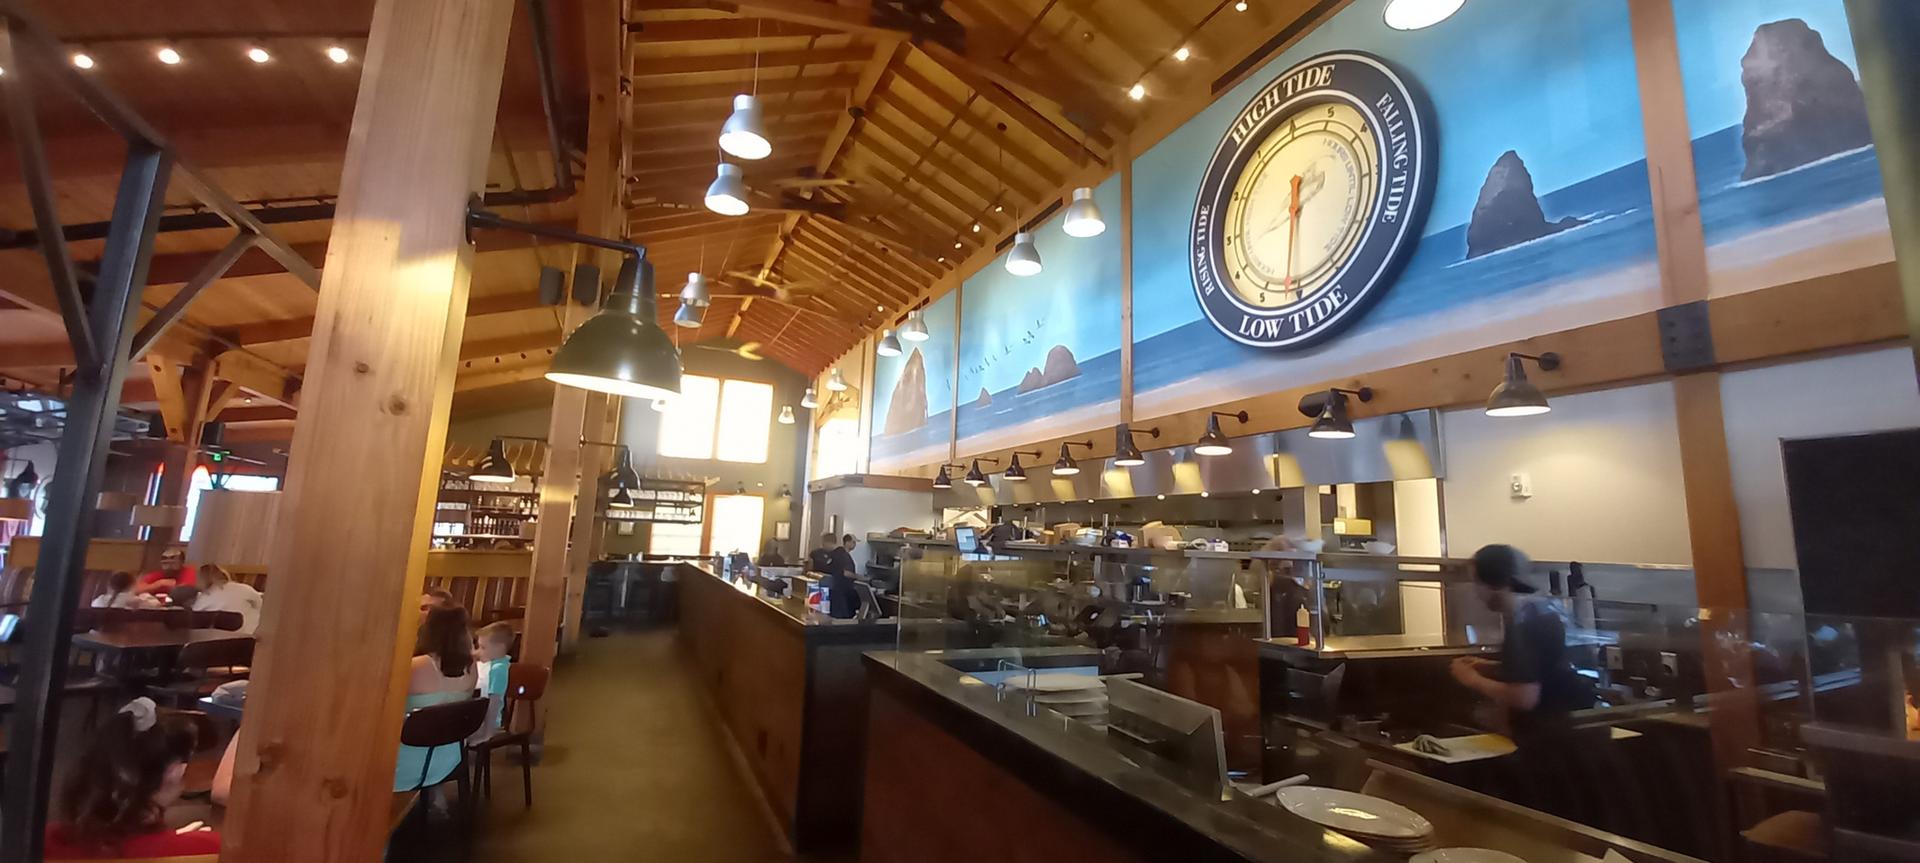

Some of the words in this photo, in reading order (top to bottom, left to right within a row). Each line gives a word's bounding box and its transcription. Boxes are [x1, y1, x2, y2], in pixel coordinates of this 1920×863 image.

[1232, 86, 1281, 146] HIGH
[1282, 64, 1335, 97] TIDE
[1327, 106, 1335, 118] 5
[1376, 92, 1408, 170] FALLING
[1233, 192, 1239, 202] 2
[1382, 170, 1407, 223] TIDE
[1196, 204, 1211, 245] TIDE
[1196, 246, 1215, 297] RISING
[1239, 314, 1284, 338] LOW
[1288, 284, 1349, 334] TIDE
[1259, 292, 1266, 303] 5
